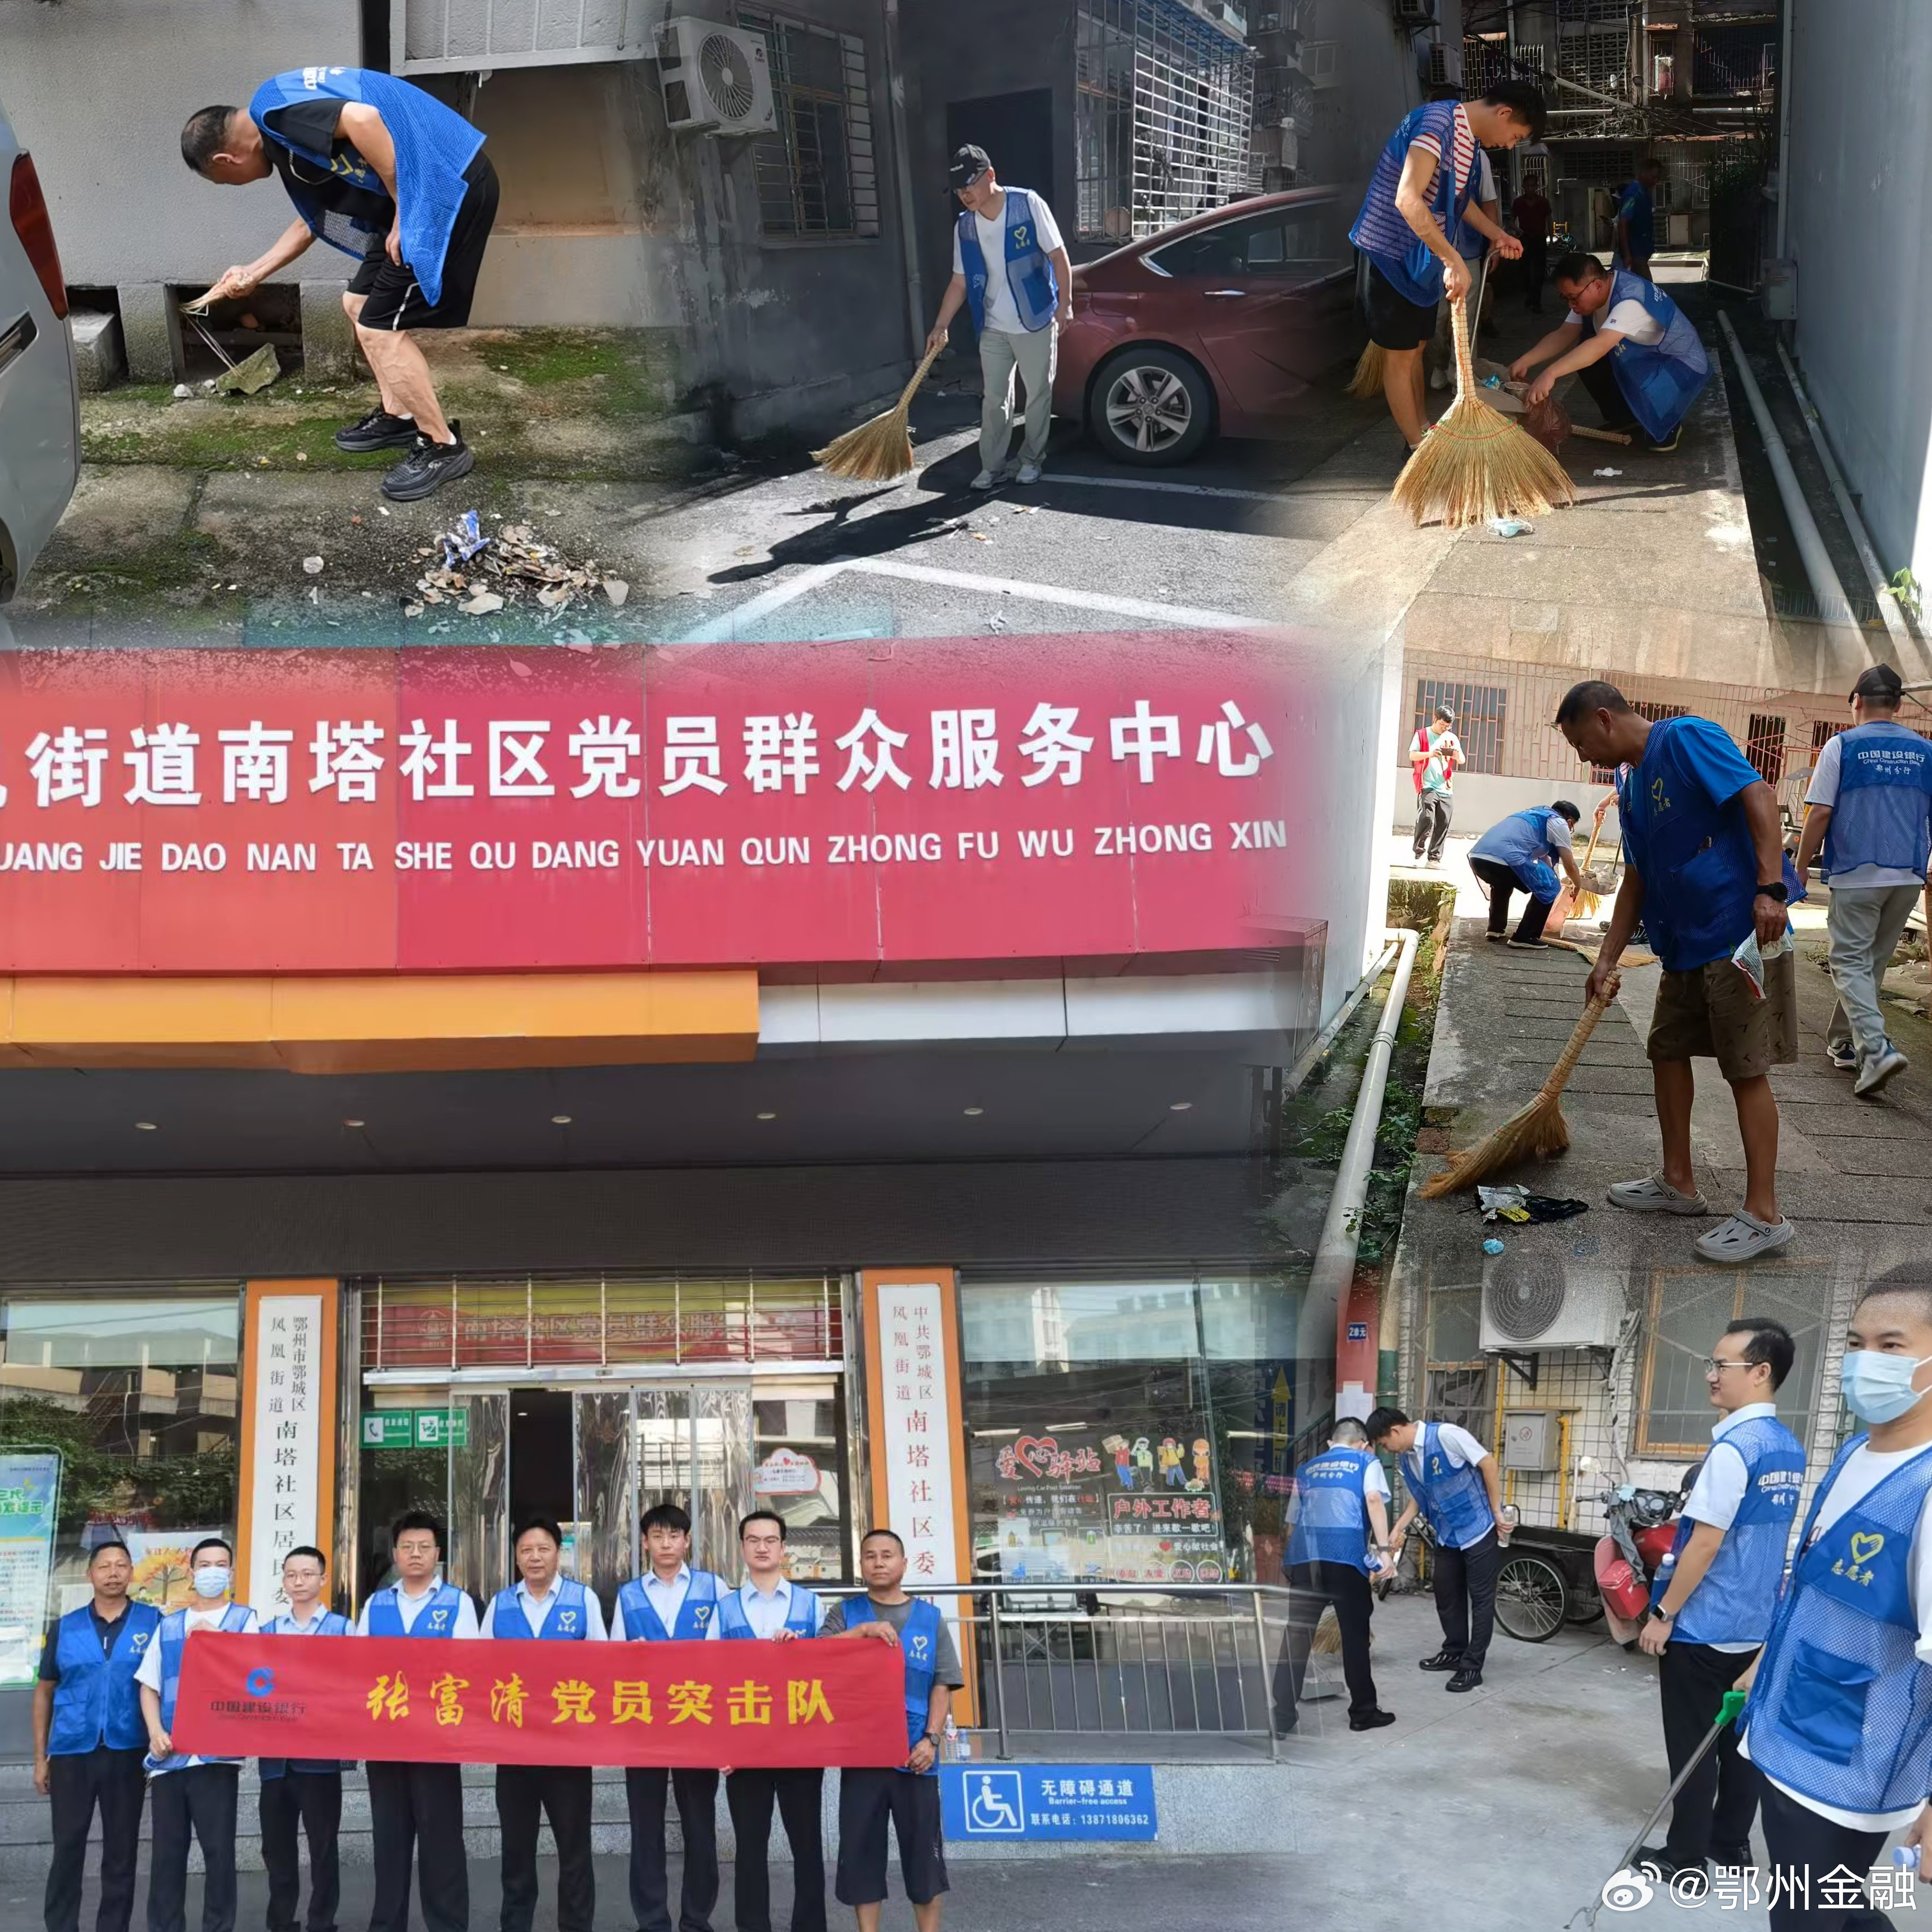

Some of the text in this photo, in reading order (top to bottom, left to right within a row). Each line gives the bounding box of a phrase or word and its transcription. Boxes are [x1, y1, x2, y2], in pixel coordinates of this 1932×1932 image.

[0, 700, 1273, 808] 街道南塔社区党员群众服务中心
[1858, 750, 1925, 762] 中国建设银行
[1876, 764, 1911, 774] 鄂州分行
[99, 842, 142, 870] JIE
[162, 843, 226, 871] DAO
[247, 843, 316, 871] NAN
[336, 843, 374, 870] TA
[395, 841, 452, 869] SHE
[470, 841, 516, 870] QU
[533, 840, 619, 868] DANG
[637, 839, 724, 866] YUAN
[741, 837, 809, 866] QUN
[828, 833, 941, 863] ZHONG
[958, 831, 999, 859] FU
[1017, 829, 1073, 858] WU
[1094, 823, 1212, 855] ZHONG
[1230, 820, 1286, 849] XIN
[269, 1316, 286, 1413] 凤凰街道
[291, 1316, 307, 1412] 鄂州市鄂城区
[893, 1306, 911, 1400] 凤凰街道
[913, 1306, 933, 1399] 中共鄂城区
[272, 1420, 297, 1621] 南塔社区居委
[907, 1409, 935, 1605] 南塔社区委
[1113, 1498, 1211, 1519] 户外工作者
[1831, 1558, 1874, 1587] 志愿者
[366, 1671, 835, 1729] 张富清党员突击队
[1041, 1780, 1134, 1797] 无障碍通道
[1049, 1797, 1098, 1805] Barrier-free
